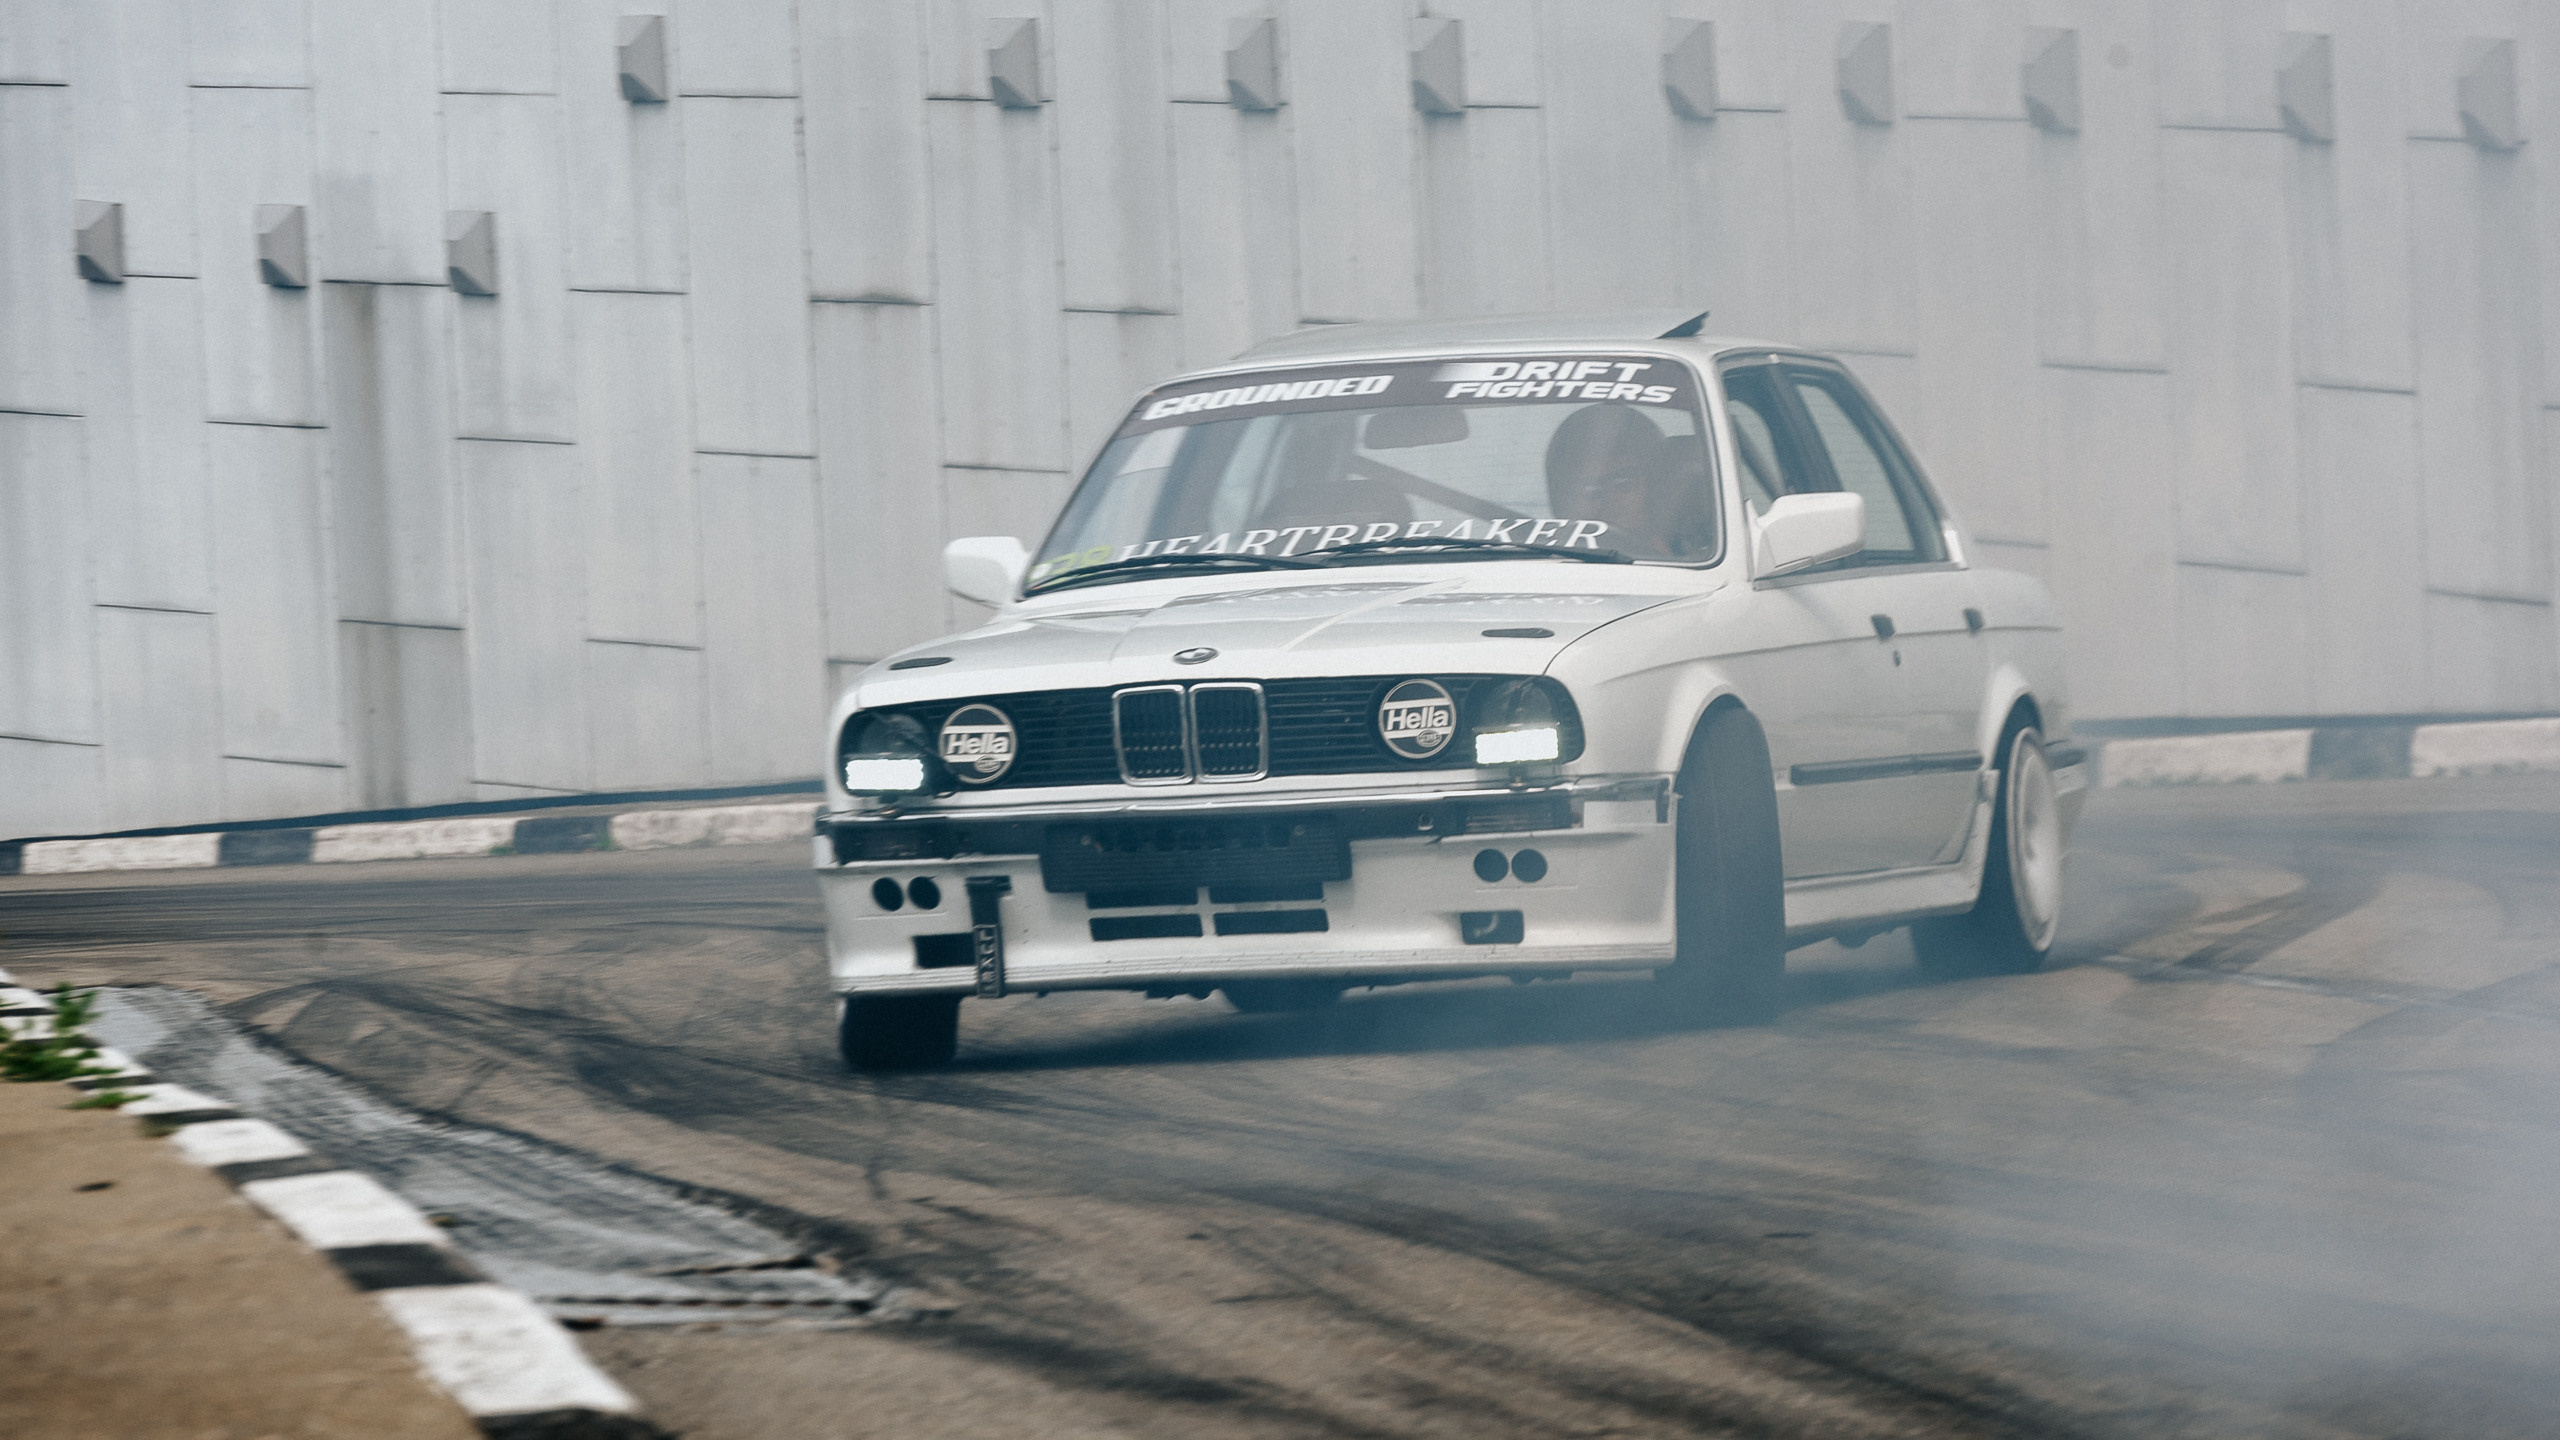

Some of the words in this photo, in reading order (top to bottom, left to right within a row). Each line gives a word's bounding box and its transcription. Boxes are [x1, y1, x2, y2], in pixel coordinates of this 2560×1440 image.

[1452, 361, 1652, 382] DRIFT
[1141, 374, 1394, 420] GROUNDED
[1444, 380, 1677, 403] FIGHTERS
[1118, 517, 1610, 559] HEARTBREAKER
[1386, 705, 1449, 731] Hella
[946, 733, 1009, 755] Hella
